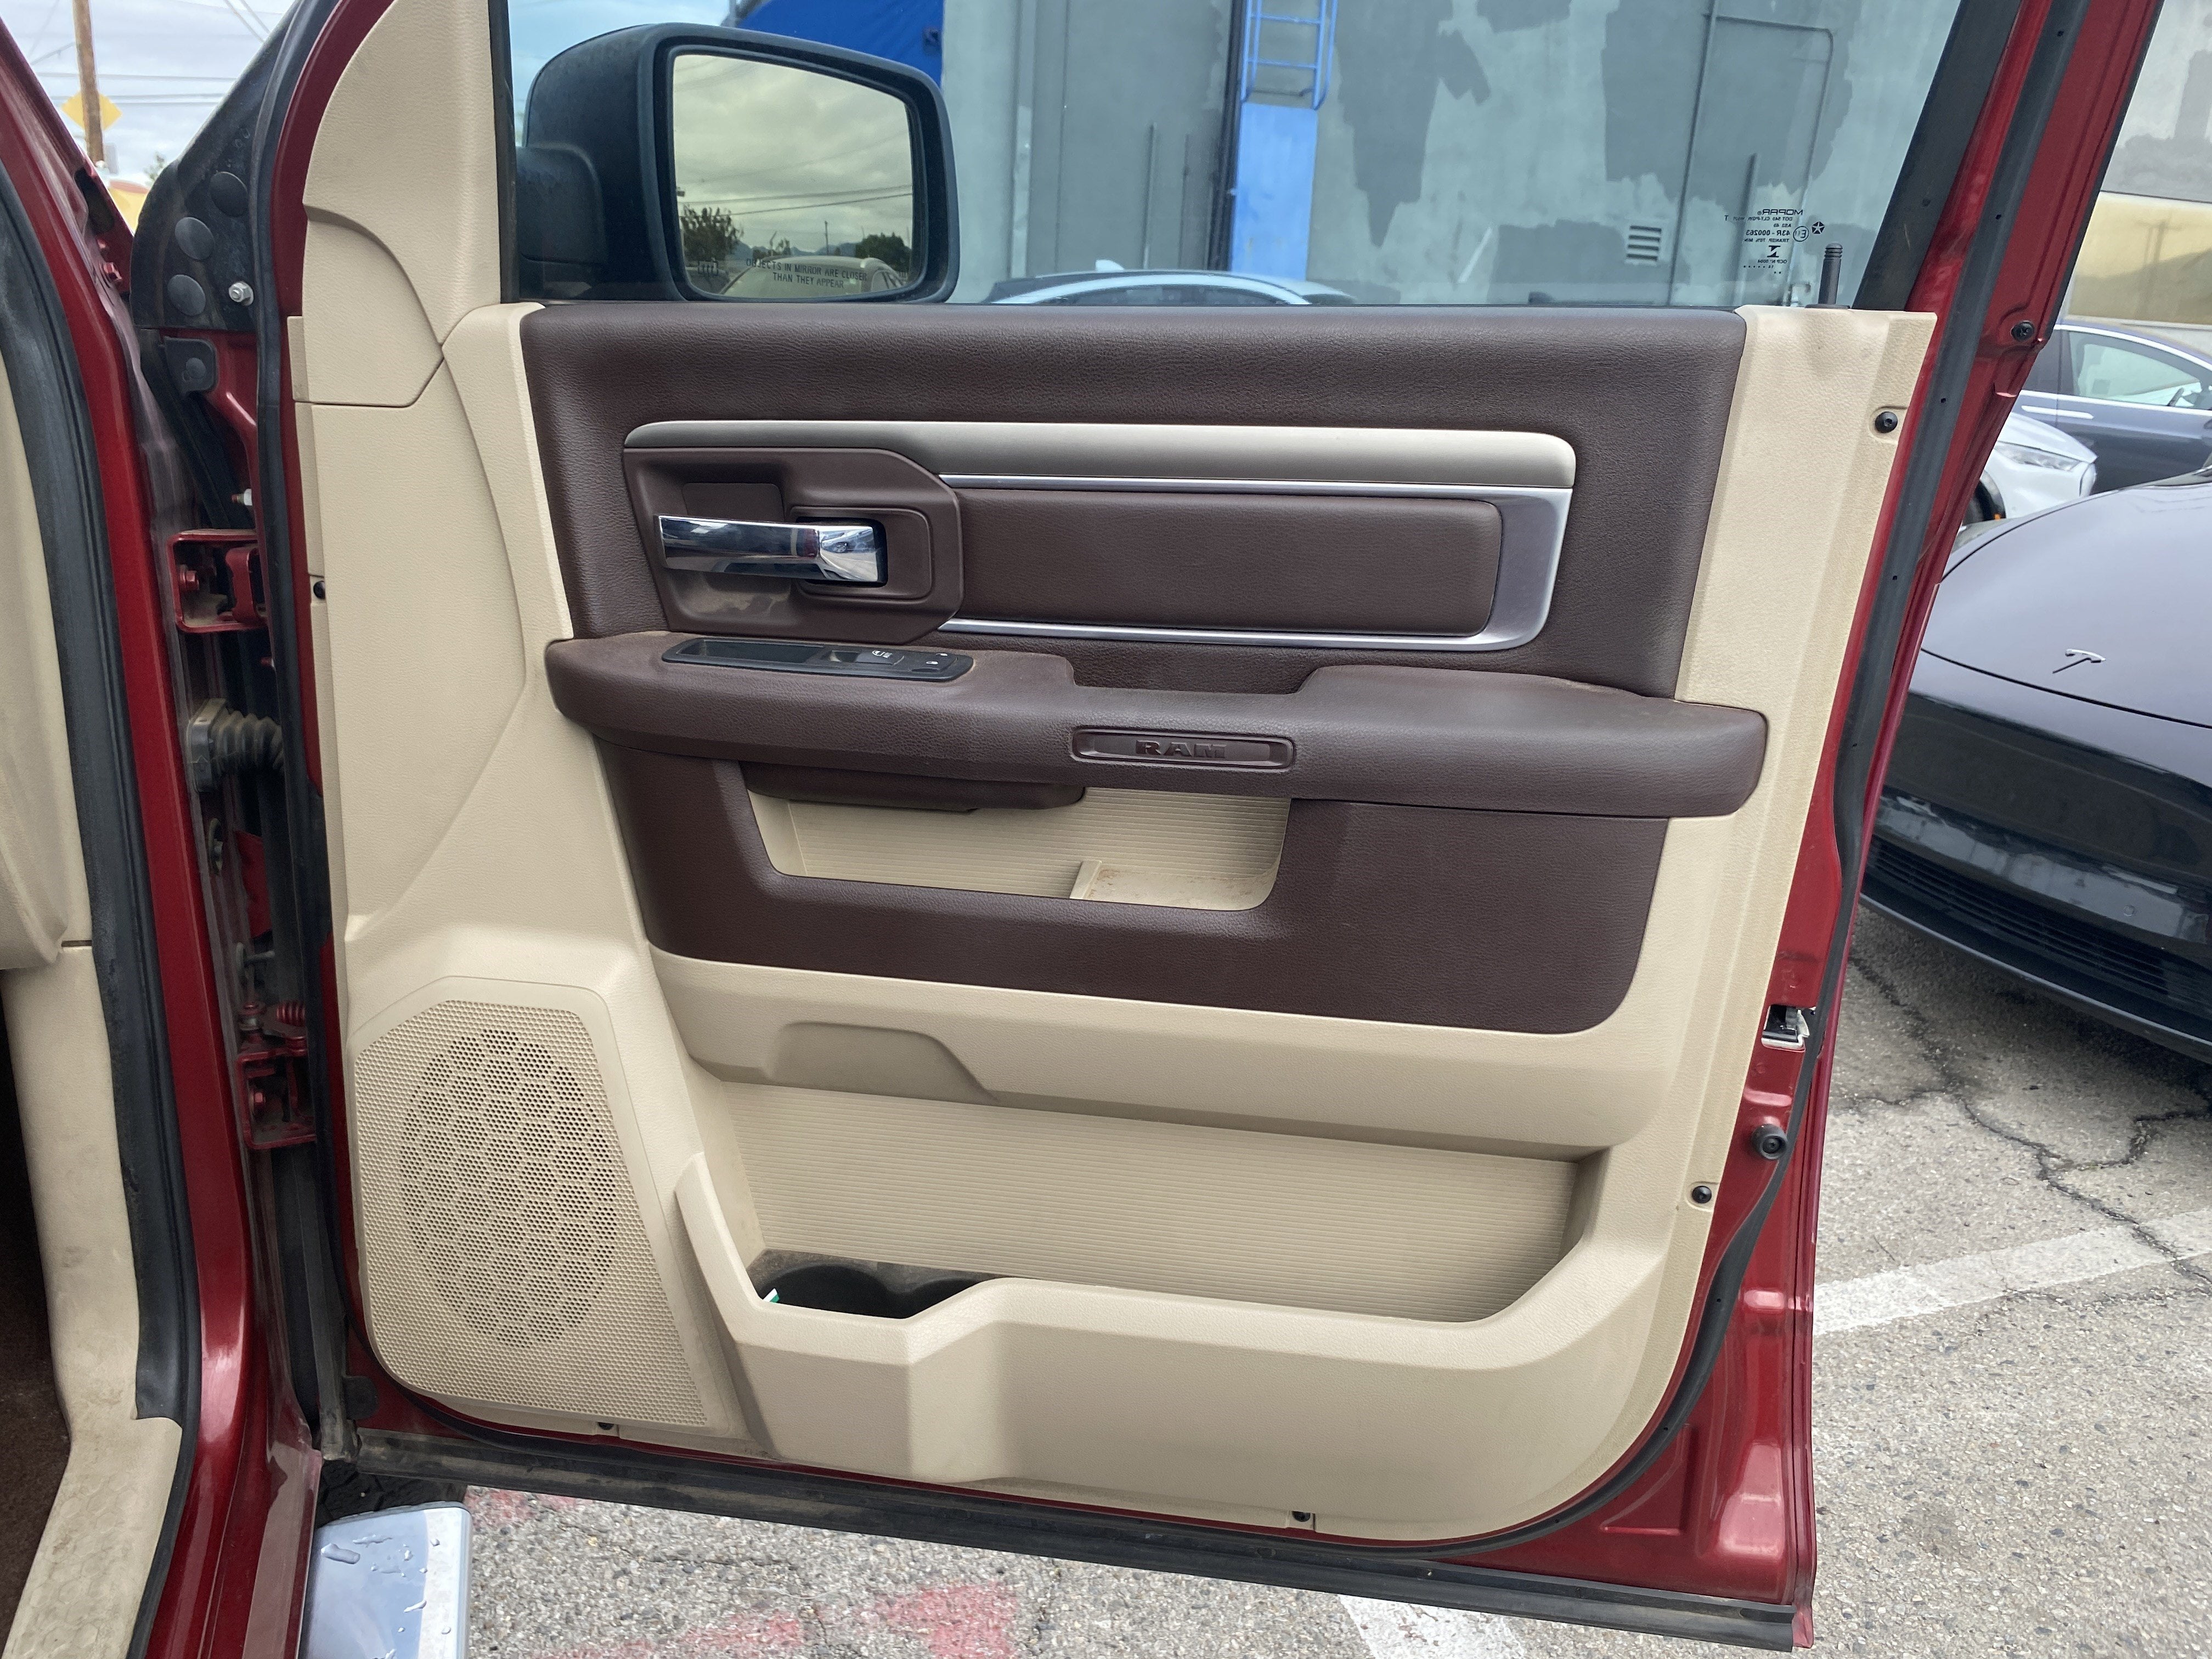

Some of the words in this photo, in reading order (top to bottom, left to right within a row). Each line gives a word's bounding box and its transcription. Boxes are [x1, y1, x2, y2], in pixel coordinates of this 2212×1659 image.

[746, 258, 781, 270] OBJECTS
[785, 263, 791, 272] IN
[795, 264, 821, 275] MIRROR
[825, 269, 838, 278] ARE
[842, 270, 867, 281] CLOSER
[773, 272, 793, 283] THAN
[797, 275, 814, 285] THEY
[816, 278, 844, 289] APPEAR
[1135, 740, 1226, 759] RAM
